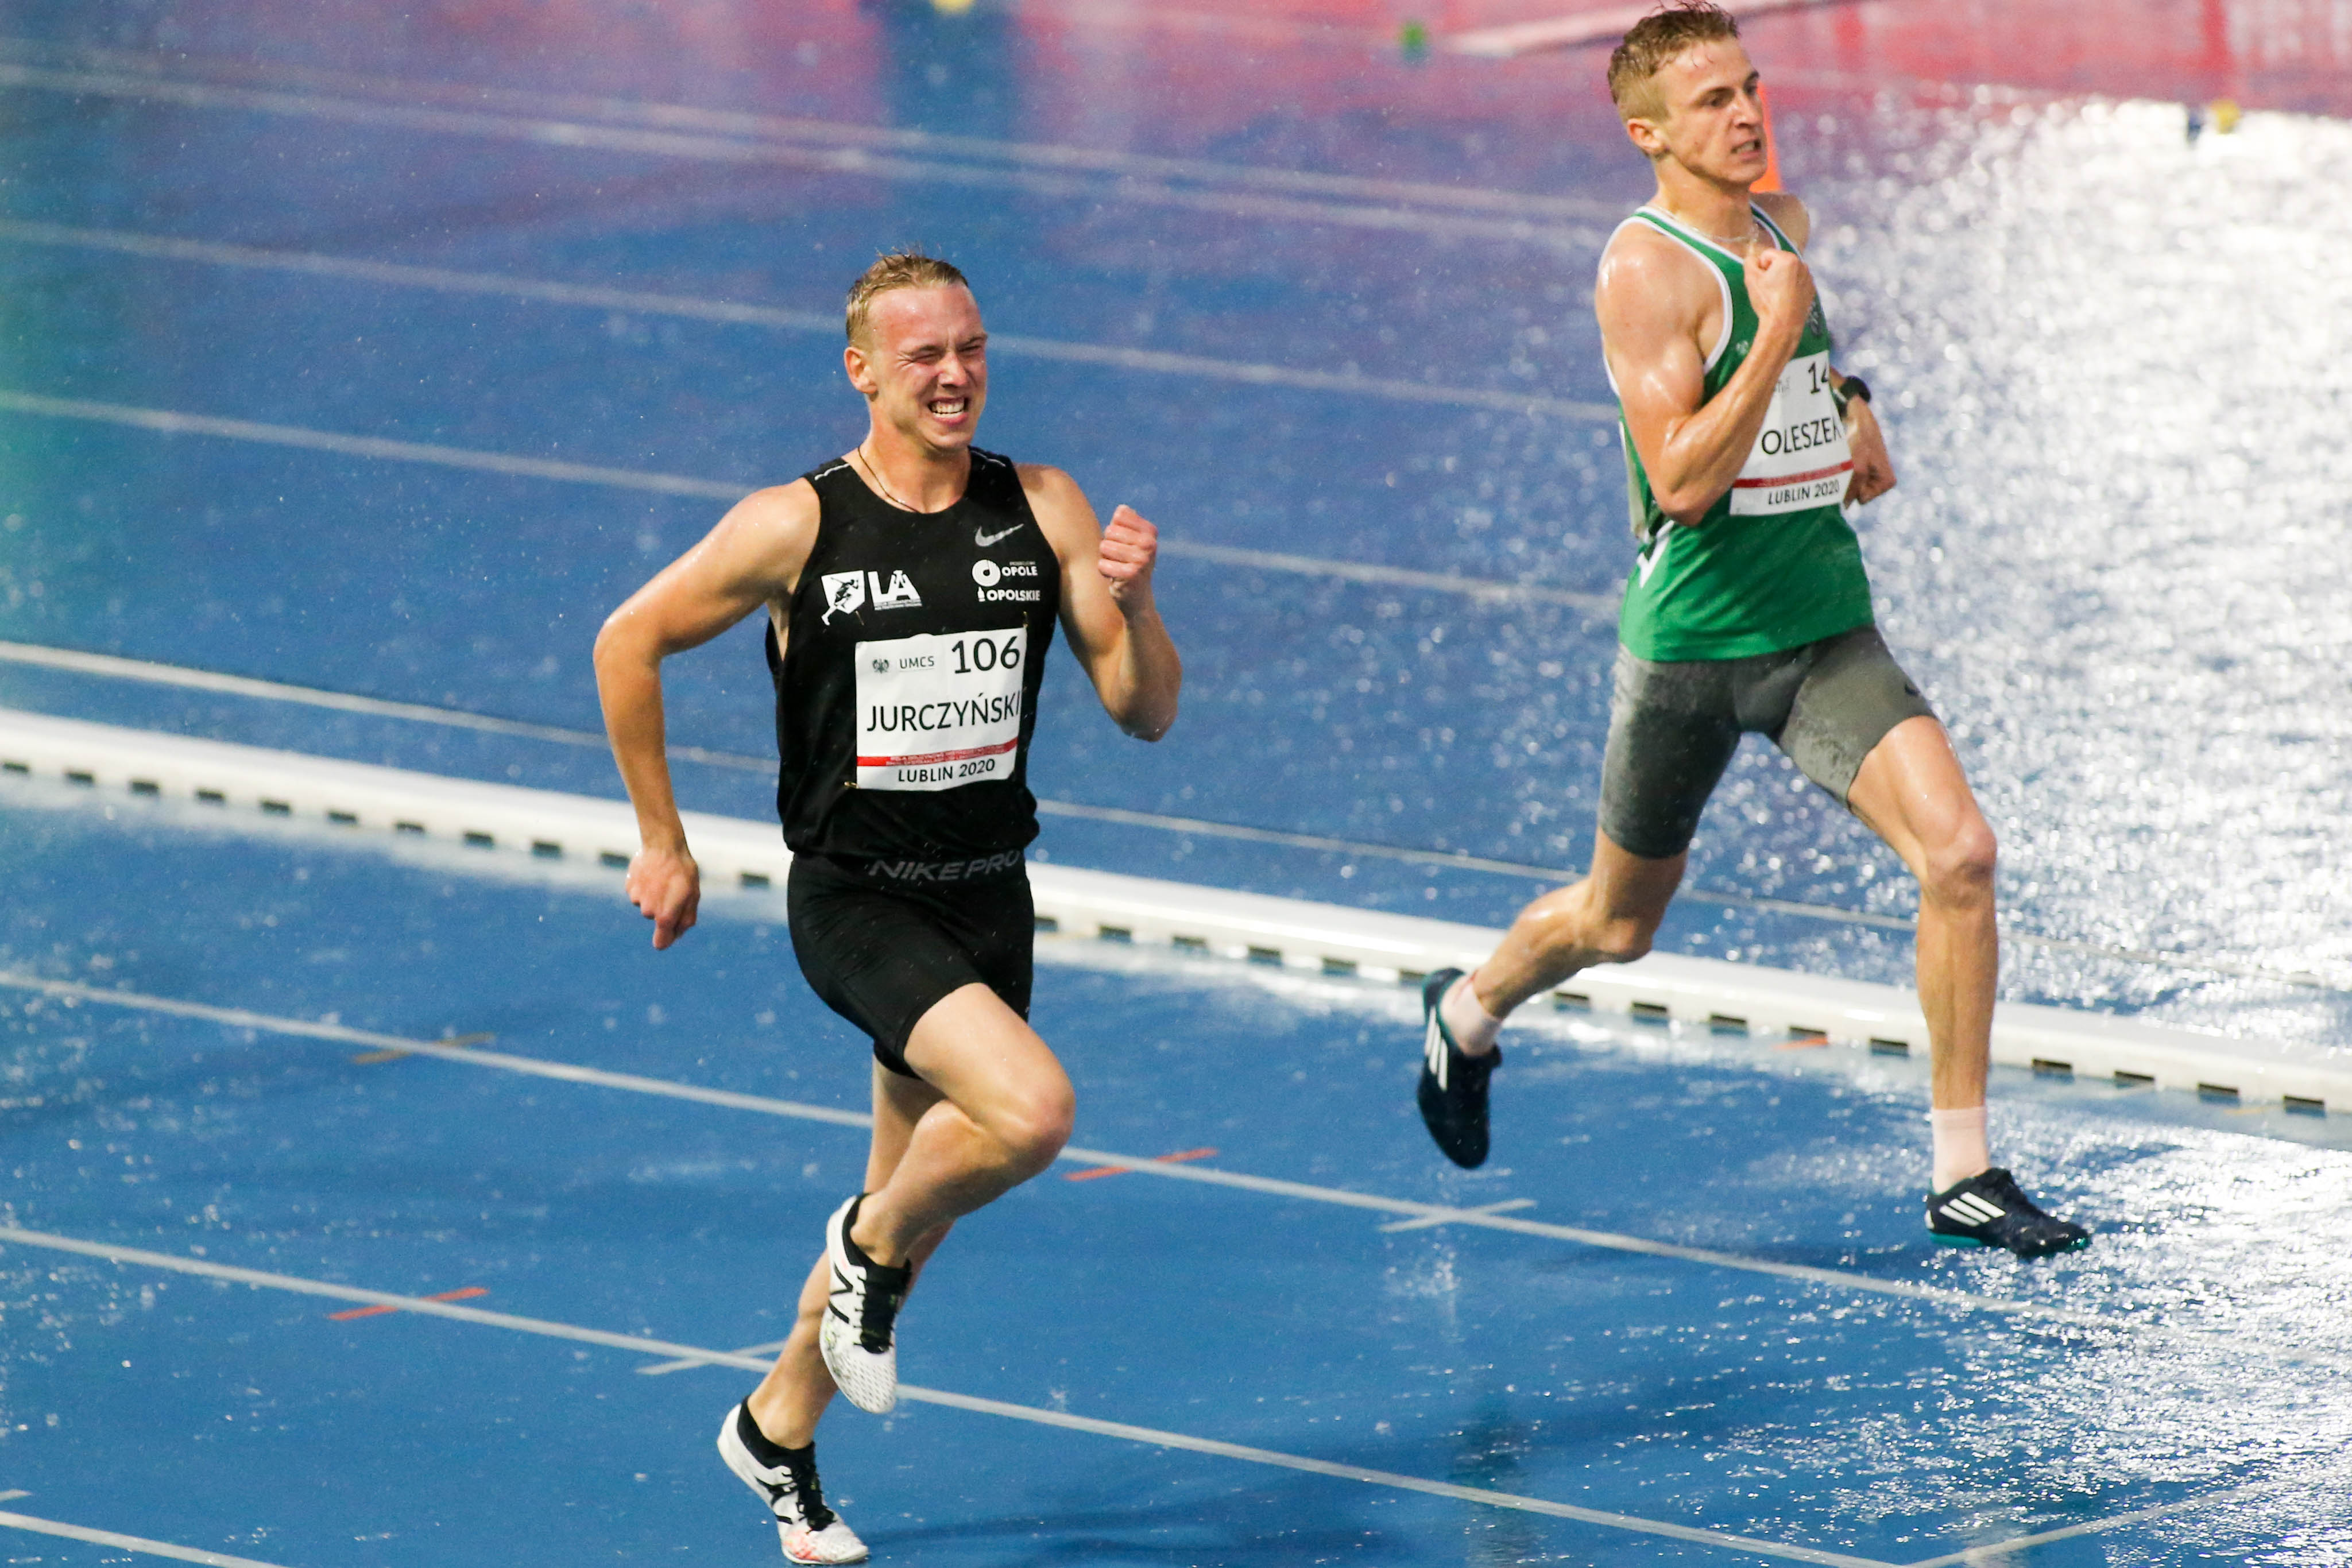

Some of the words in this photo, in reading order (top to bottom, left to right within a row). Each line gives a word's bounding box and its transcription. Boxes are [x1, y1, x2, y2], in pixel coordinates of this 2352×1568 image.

[1768, 486, 1809, 505] LUBLIN
[1815, 479, 1840, 497] 2020
[1001, 566, 1038, 576] OPOLE
[987, 589, 1040, 601] OPOLSKIE
[899, 656, 935, 669] UMCS
[951, 636, 1020, 674] 106
[866, 690, 1021, 732] JURCZYŃSKI
[898, 766, 953, 782] LUBLIN
[958, 758, 995, 777] 2020
